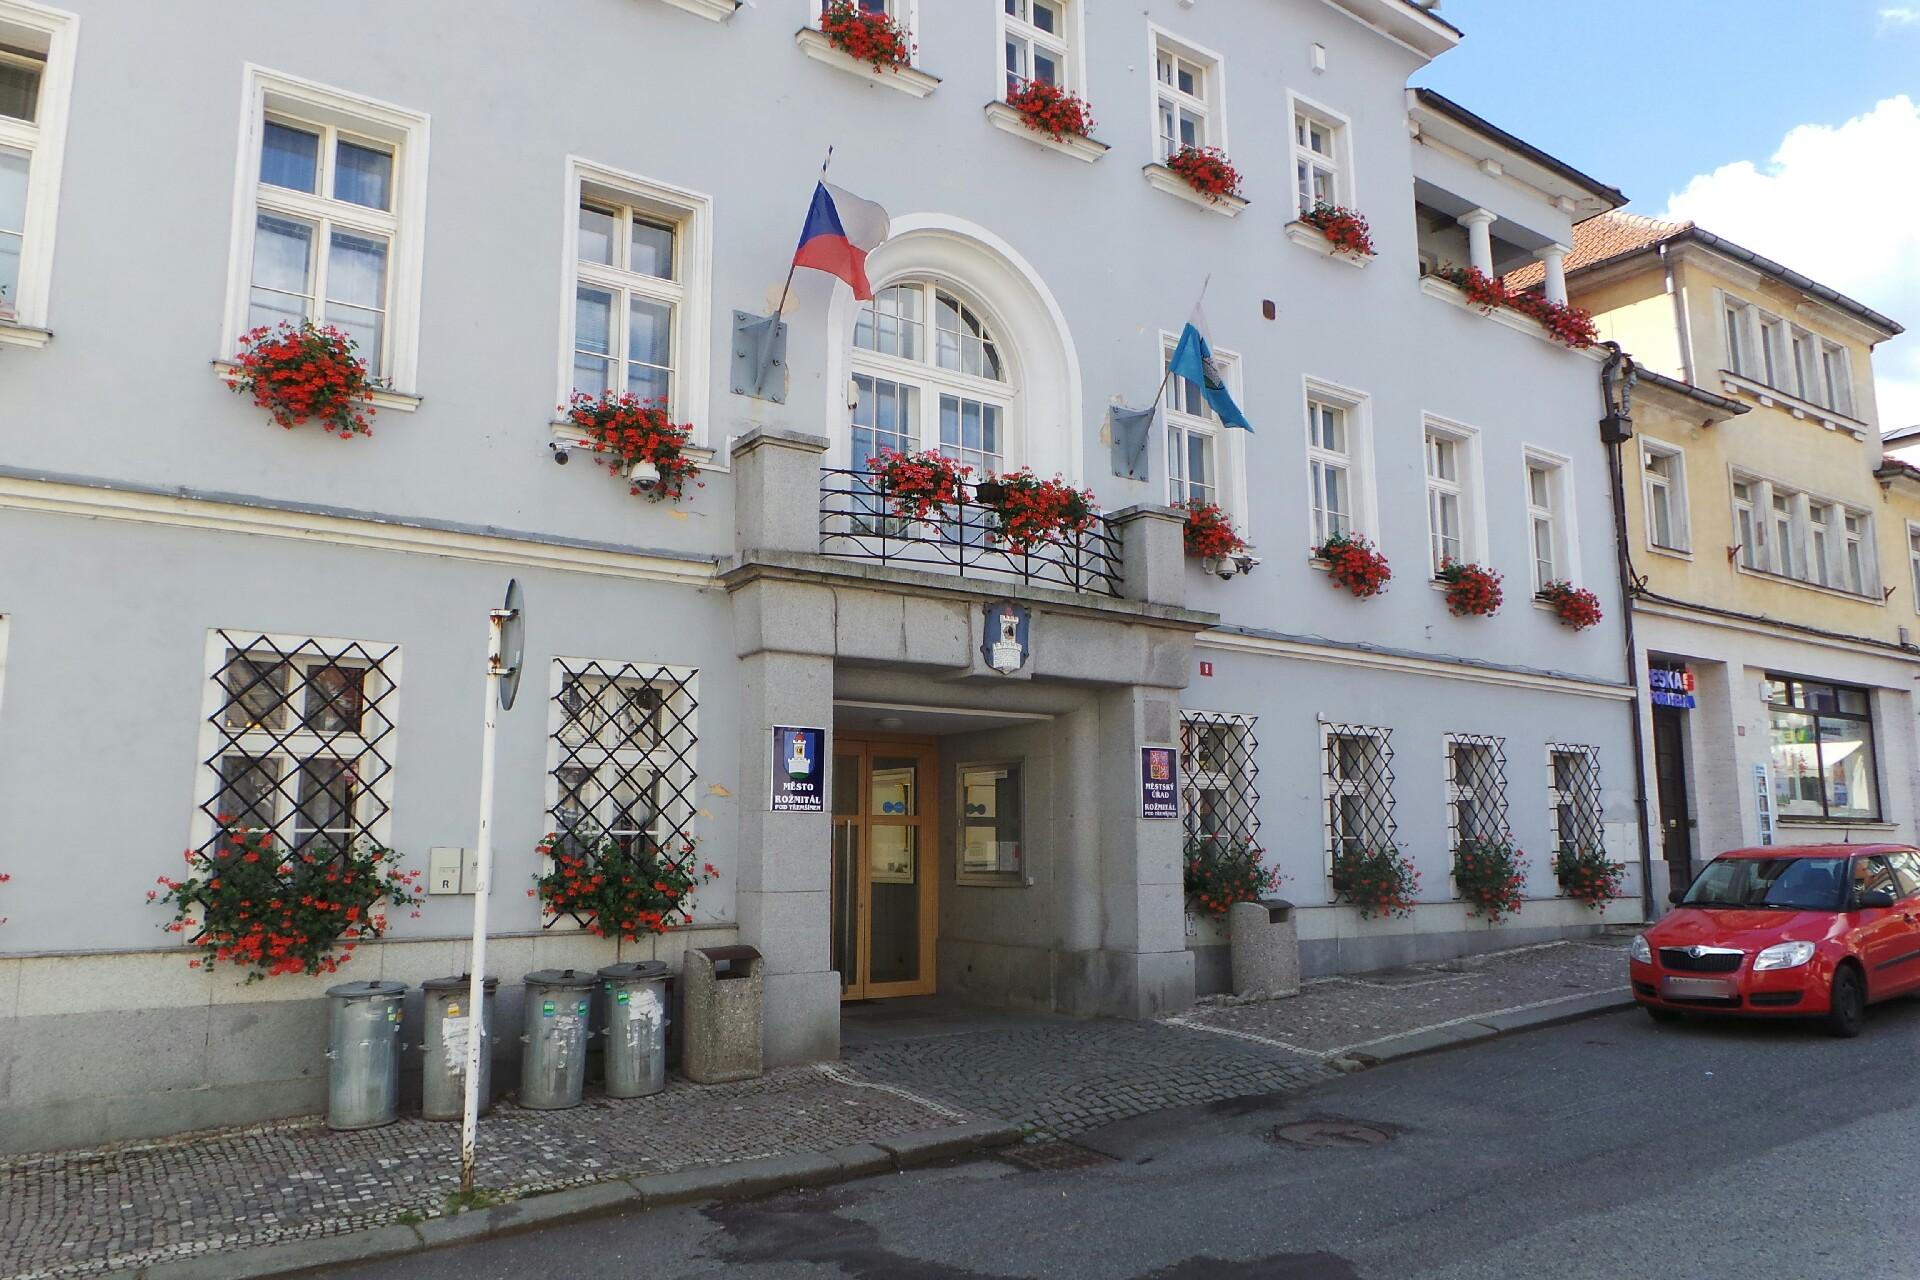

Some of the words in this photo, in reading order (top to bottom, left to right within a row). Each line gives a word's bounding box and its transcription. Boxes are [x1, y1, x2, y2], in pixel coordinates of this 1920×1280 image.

[783, 781, 814, 791] MĚSTO
[1145, 782, 1175, 791] MĚSTSKÝ
[774, 794, 821, 804] ROŽMITÁL
[1151, 790, 1170, 799] ÚŘAD
[1144, 803, 1177, 811] ROŽMITÁL
[442, 879, 450, 889] R
